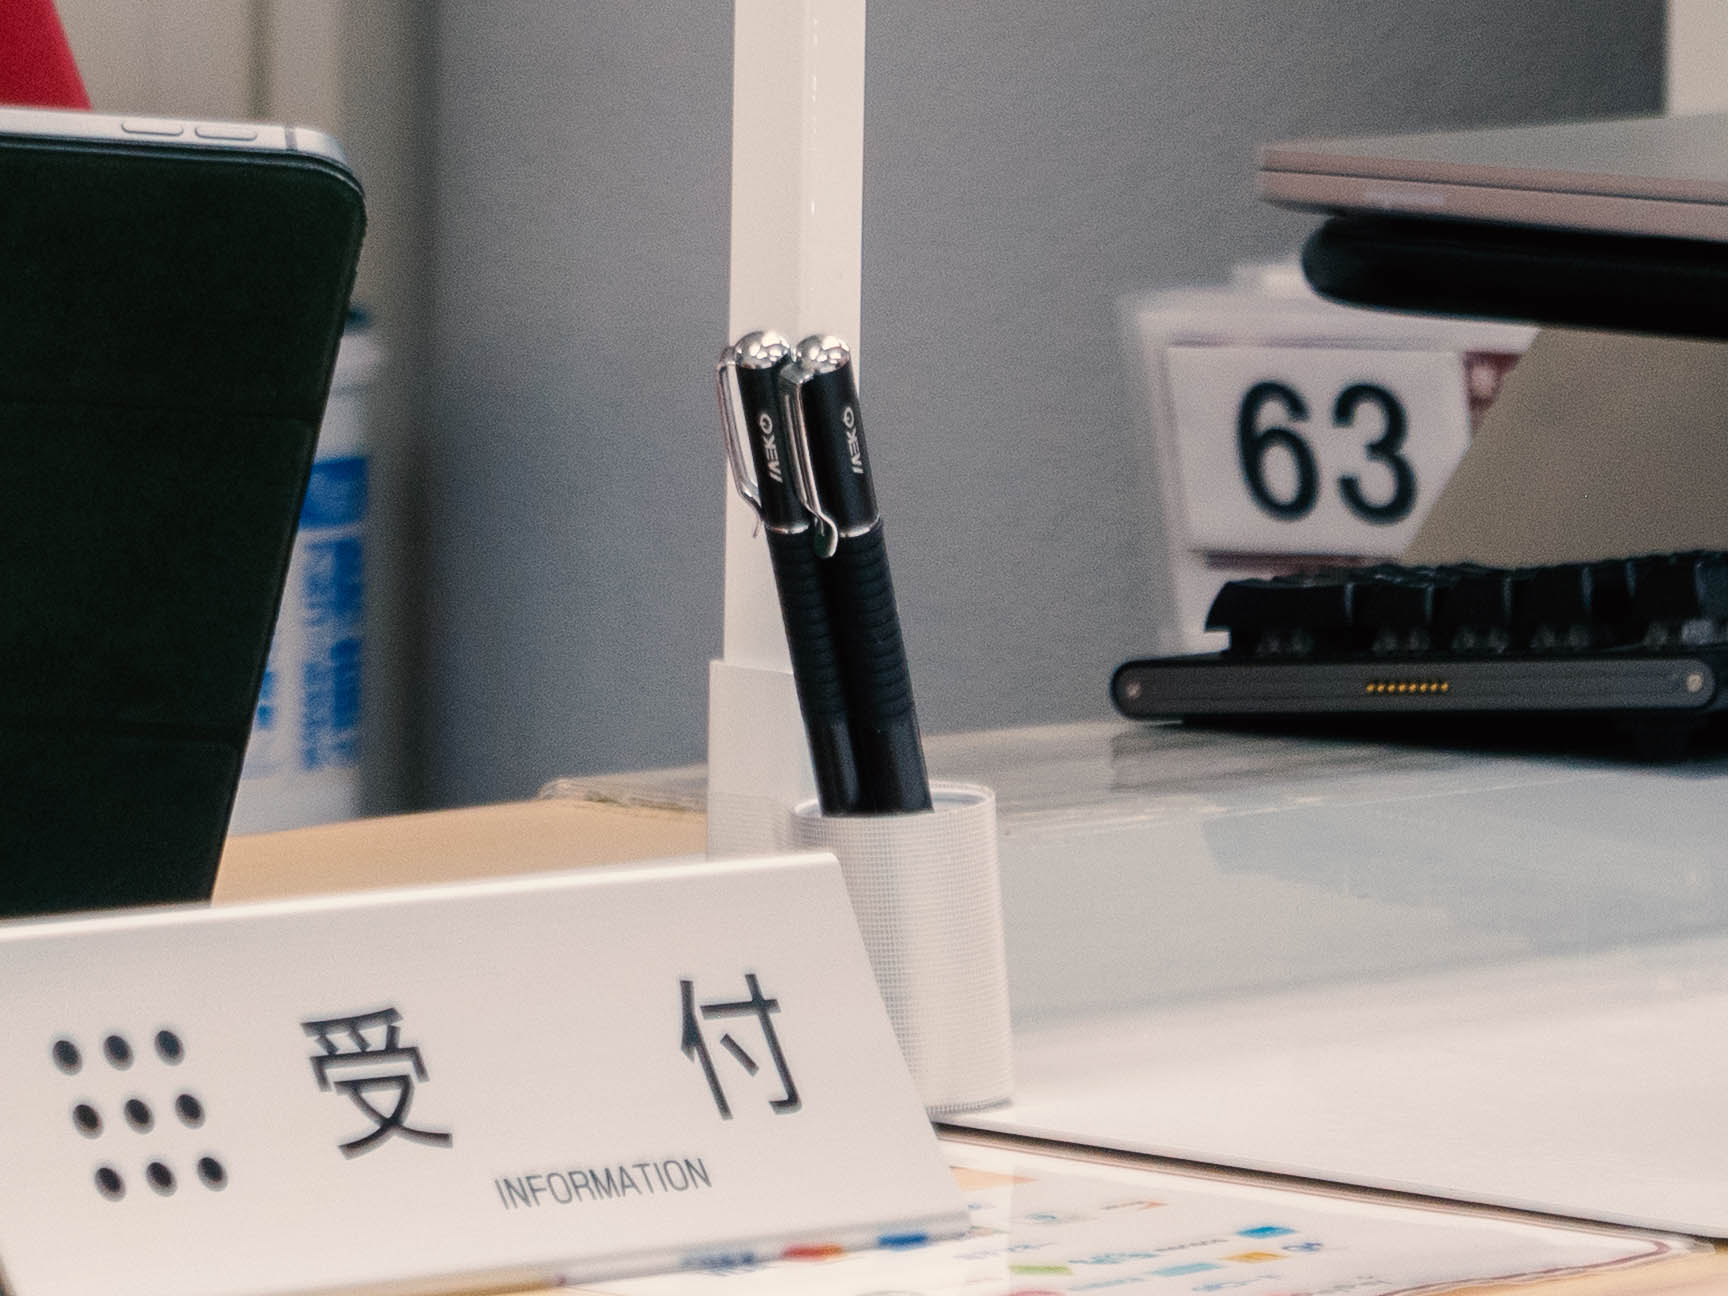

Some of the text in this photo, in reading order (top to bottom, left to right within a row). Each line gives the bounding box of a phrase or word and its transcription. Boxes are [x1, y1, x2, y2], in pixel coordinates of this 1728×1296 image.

[1239, 380, 1417, 525] 63
[299, 973, 804, 1161] 受付
[493, 1156, 712, 1210] INFORMATION
